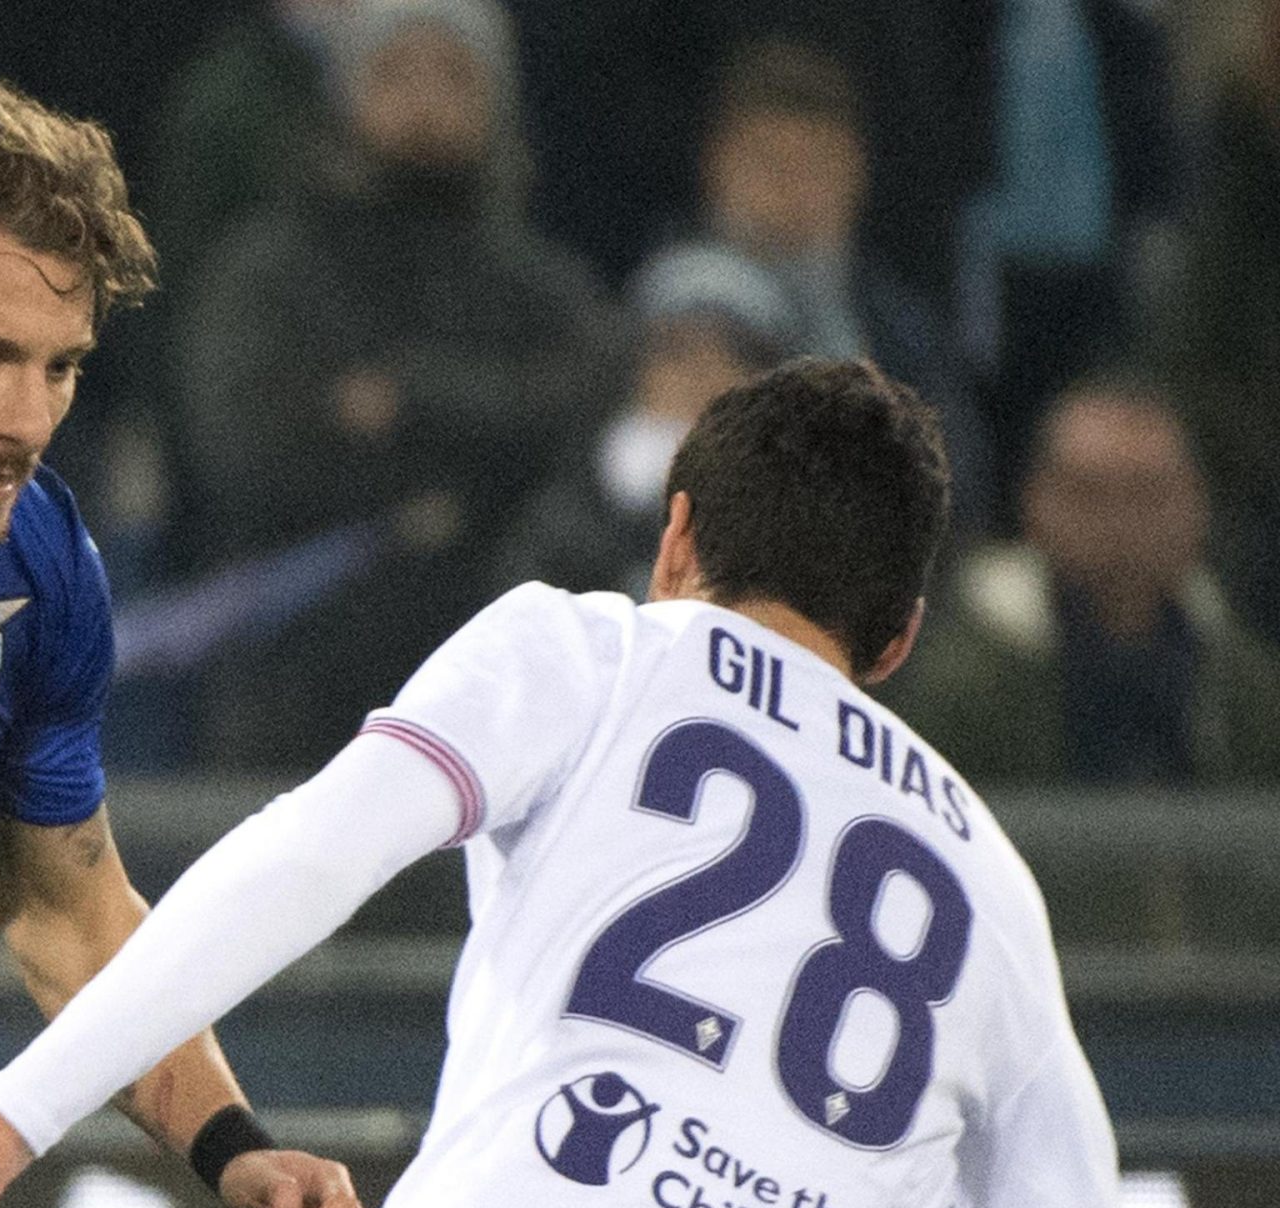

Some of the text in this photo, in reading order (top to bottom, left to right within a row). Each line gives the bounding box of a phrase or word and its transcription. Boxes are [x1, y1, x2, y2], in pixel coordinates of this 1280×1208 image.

[710, 627, 972, 842] GIL DIAS
[561, 717, 974, 1151] 28
[673, 1117, 781, 1203] Save
